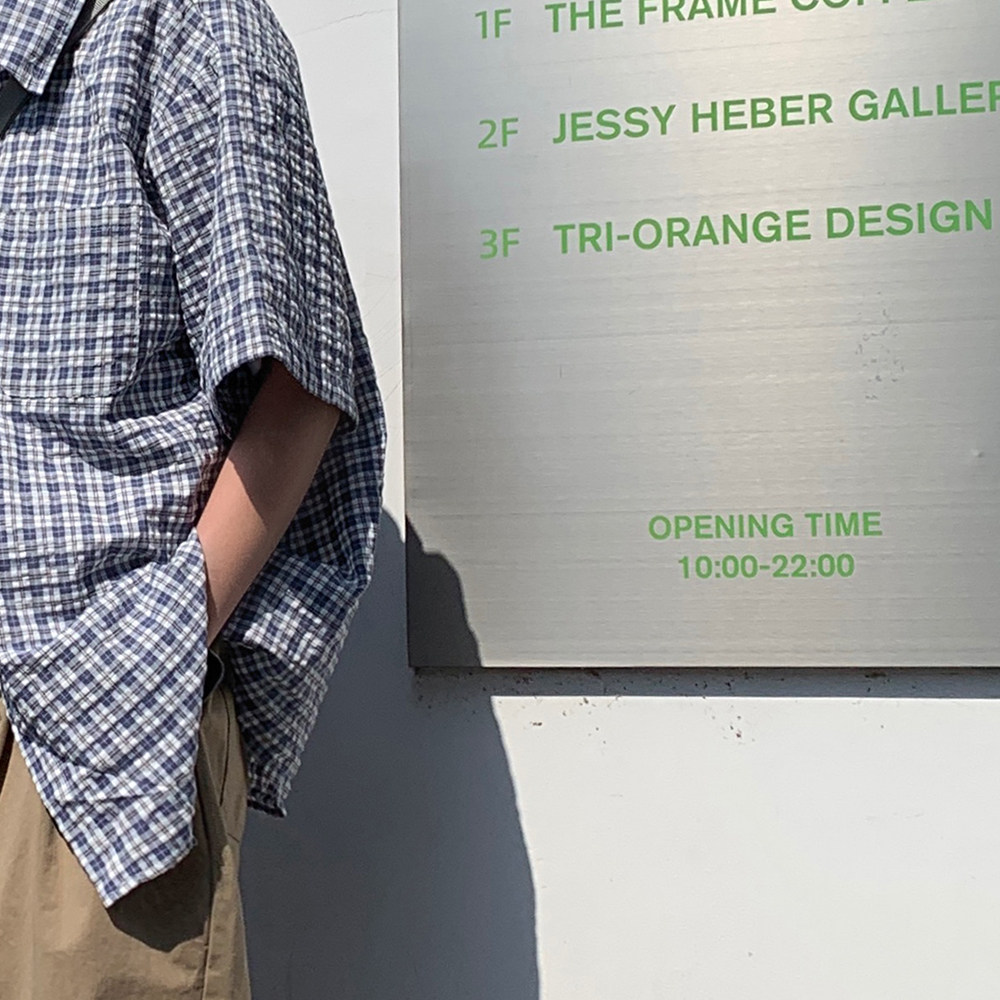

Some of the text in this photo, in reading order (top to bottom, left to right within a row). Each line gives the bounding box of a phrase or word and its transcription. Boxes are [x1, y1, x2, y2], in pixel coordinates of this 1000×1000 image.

[475, 9, 512, 41] 1F
[543, 0, 625, 34] THE
[477, 117, 520, 150] 2F
[552, 104, 677, 145] JESSY
[690, 92, 834, 134] HEBER
[478, 197, 994, 260] 3F TRI-ORANGE DESIGN
[647, 510, 883, 541] OPENING TIME
[678, 552, 856, 580] 10:00-22:00
